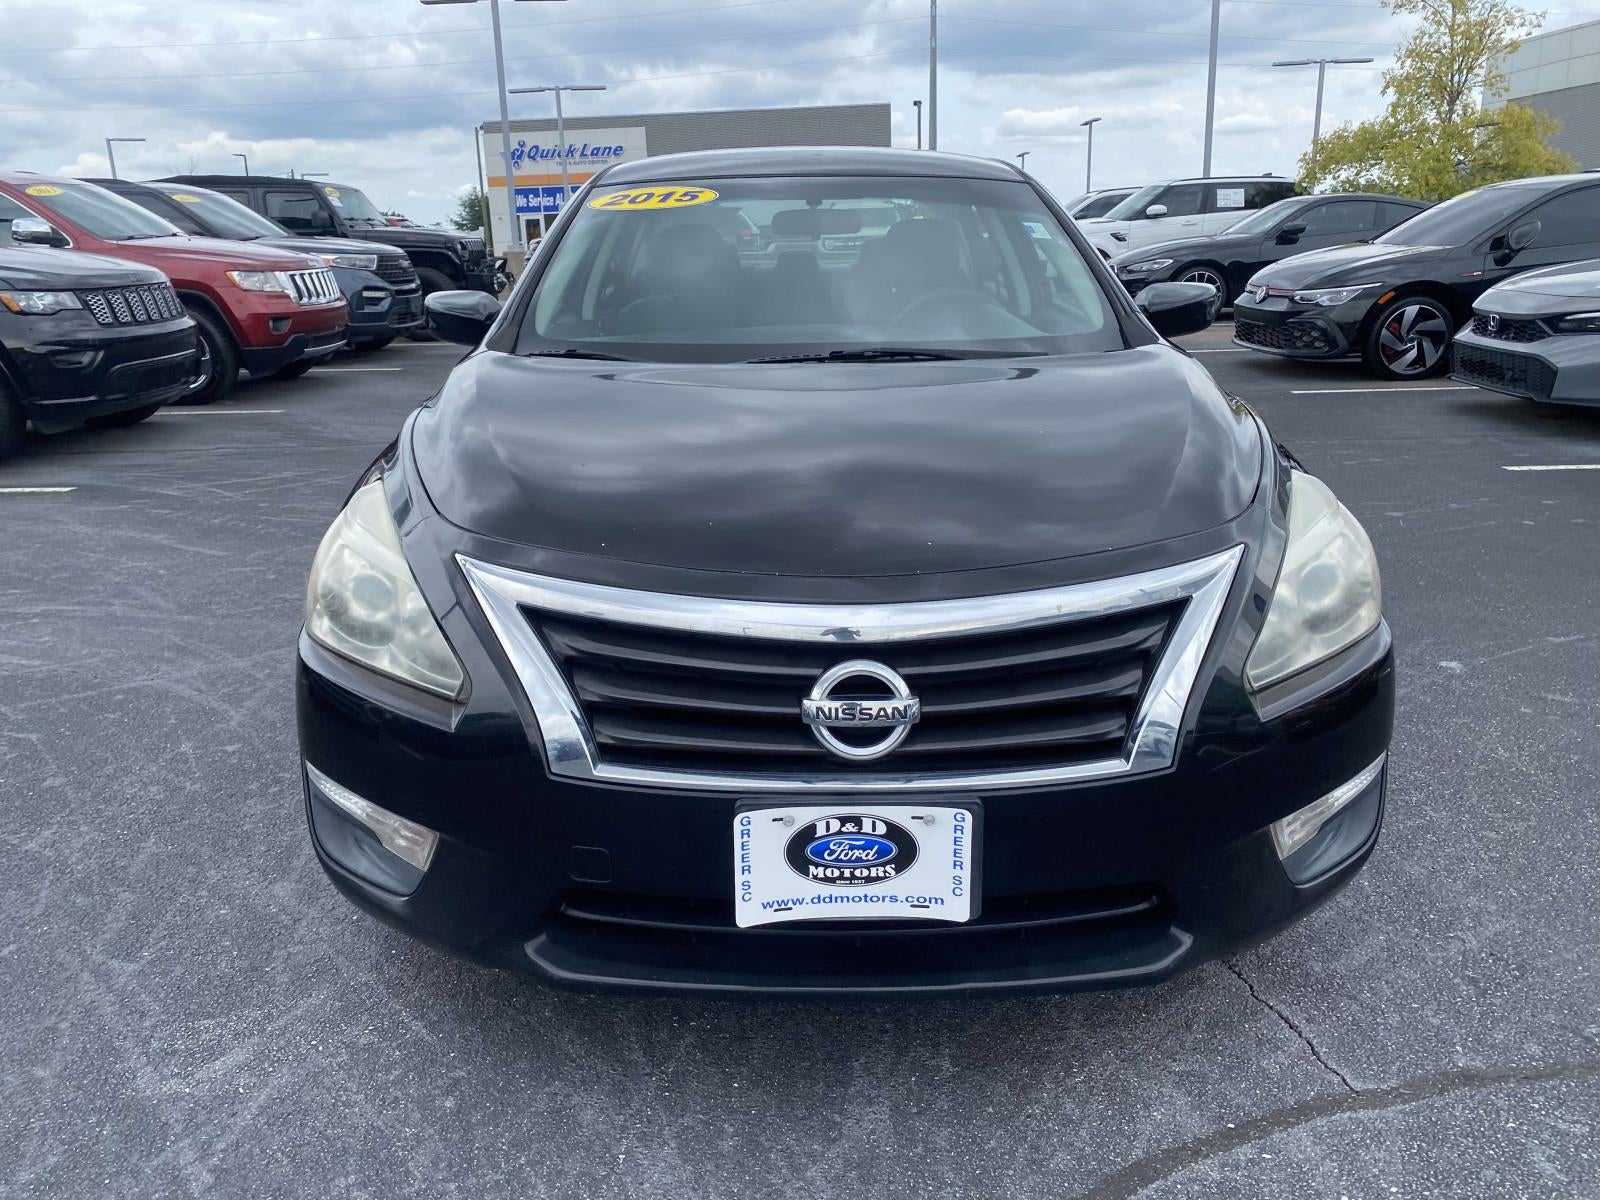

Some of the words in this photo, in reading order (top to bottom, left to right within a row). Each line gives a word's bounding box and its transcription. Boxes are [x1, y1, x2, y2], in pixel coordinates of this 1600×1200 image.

[580, 143, 624, 158] Lane
[516, 194, 527, 207] We
[528, 193, 554, 207] Service
[555, 193, 565, 206] AL
[600, 190, 705, 207] 2015
[815, 705, 908, 721] NISSAN
[815, 817, 887, 837] D&D
[740, 816, 752, 875] GREER
[823, 839, 879, 861] Ford
[952, 812, 965, 871] GREER
[808, 863, 896, 879] MOTORS
[741, 880, 752, 903] SC
[951, 875, 963, 897] SC
[761, 893, 945, 909] www.ddmotors.com
